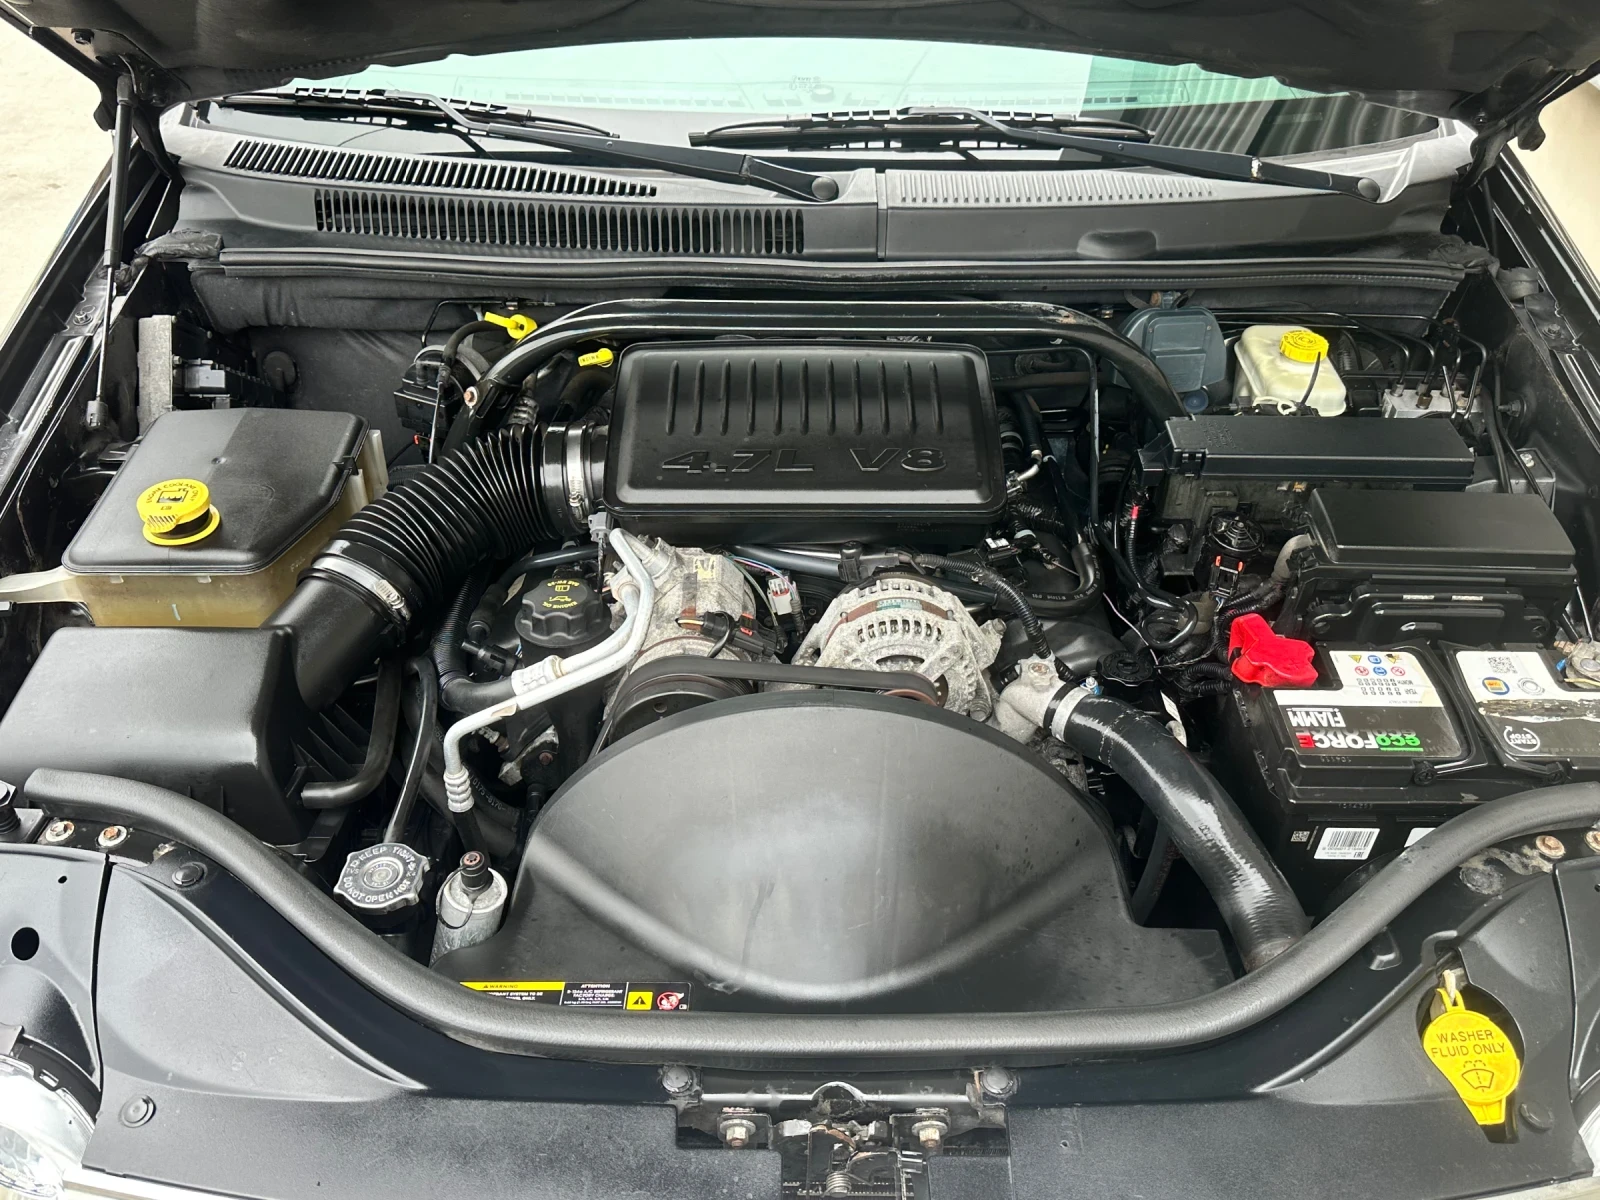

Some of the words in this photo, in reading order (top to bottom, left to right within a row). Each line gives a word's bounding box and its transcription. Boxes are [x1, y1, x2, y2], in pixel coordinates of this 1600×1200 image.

[661, 449, 814, 473] 4.7L
[850, 448, 947, 472] V8
[1287, 710, 1346, 727] FIAMM
[1296, 734, 1421, 749] ecoFORCE
[359, 846, 388, 861] KEEP
[392, 846, 416, 862] TIGHT
[348, 887, 365, 901] NOT
[365, 892, 394, 903] OPEN
[393, 879, 411, 896] HOT
[1436, 1030, 1494, 1043] WASHER
[1431, 1046, 1469, 1057] FLUID
[1473, 1042, 1506, 1054] ONLY
